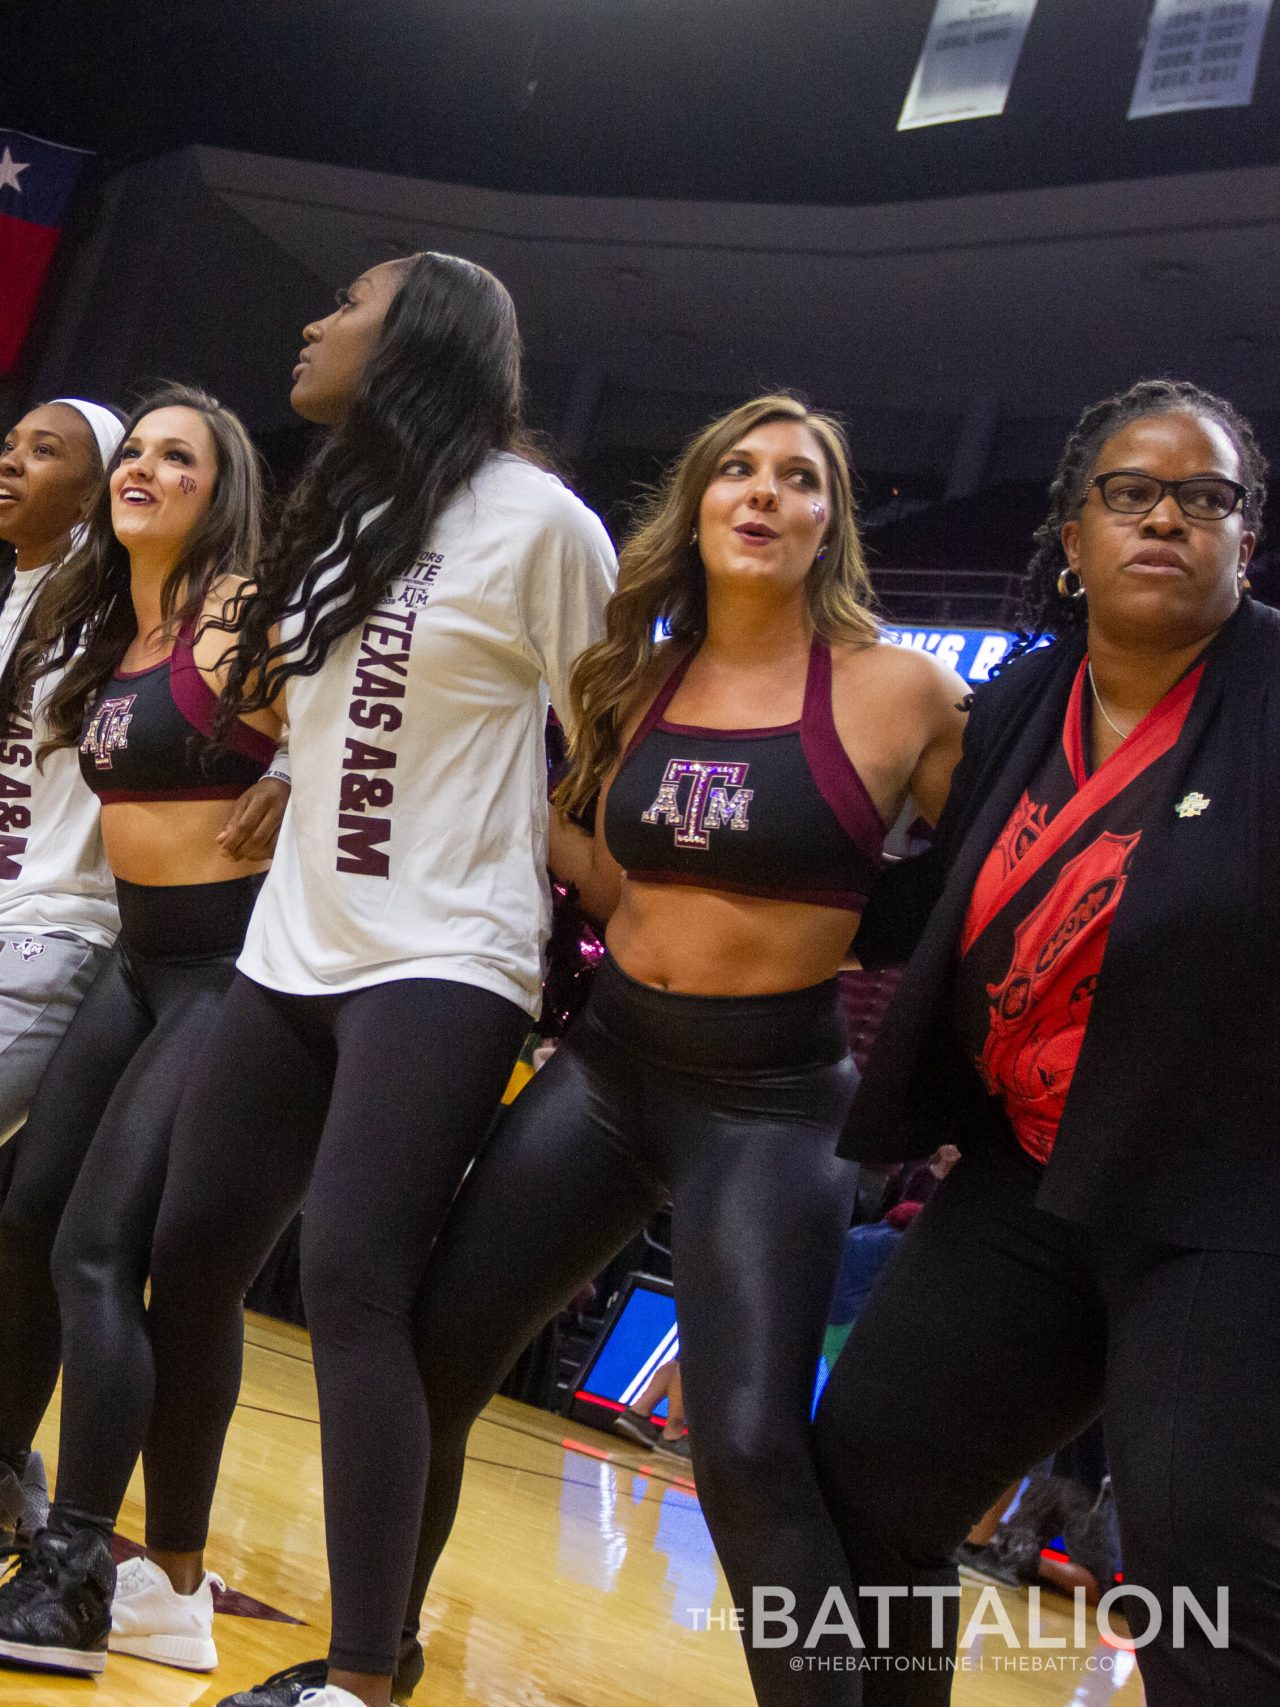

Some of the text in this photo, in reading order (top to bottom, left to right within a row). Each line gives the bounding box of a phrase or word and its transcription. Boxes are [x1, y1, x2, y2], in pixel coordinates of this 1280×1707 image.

[403, 562, 442, 582] ITE
[336, 608, 417, 880] TEXAS A&M
